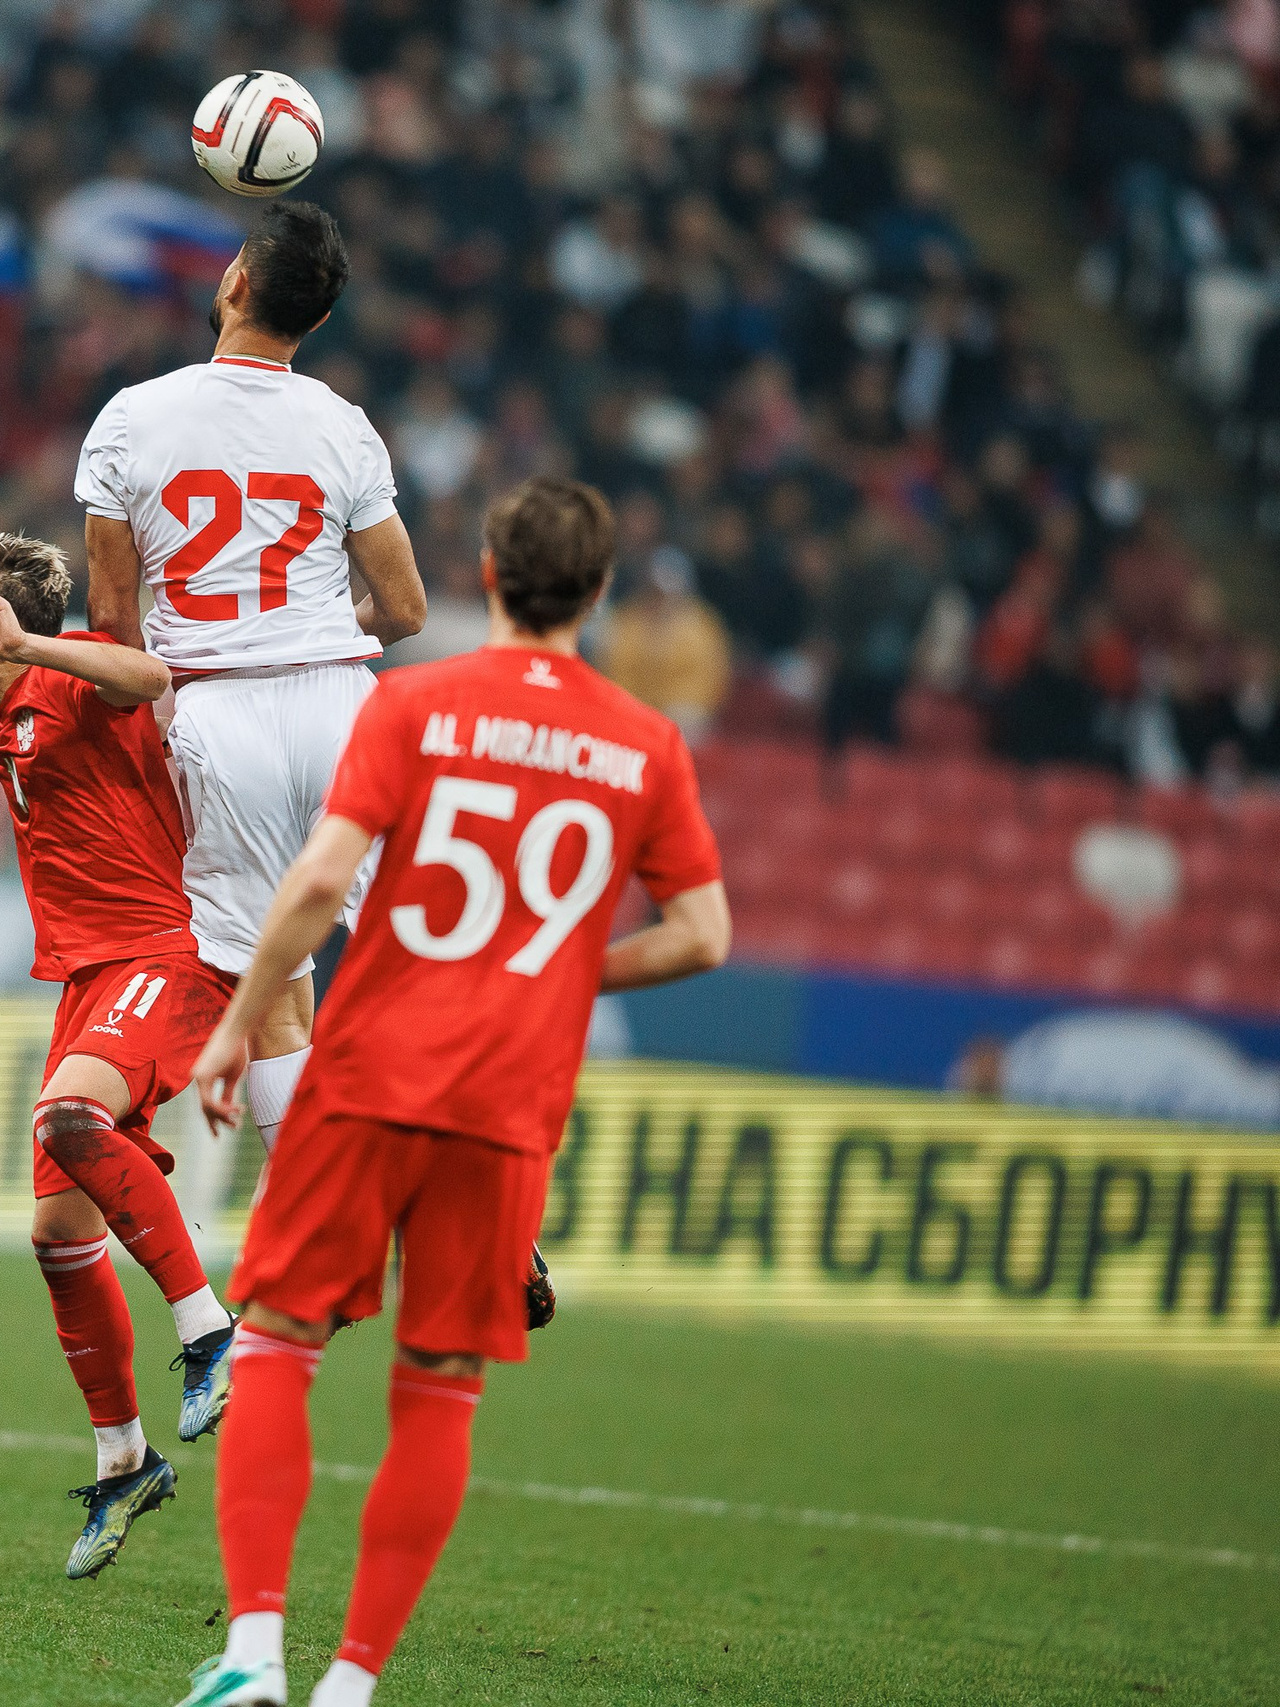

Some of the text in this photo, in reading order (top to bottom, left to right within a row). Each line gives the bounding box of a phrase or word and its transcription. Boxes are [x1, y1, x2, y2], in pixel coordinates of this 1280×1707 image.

[161, 468, 326, 622] 27
[471, 714, 648, 796] MIRANCHUK
[389, 774, 616, 978] 59
[88, 1024, 124, 1038] JOGEL
[113, 972, 167, 1020] 11
[619, 1110, 774, 1267] НА
